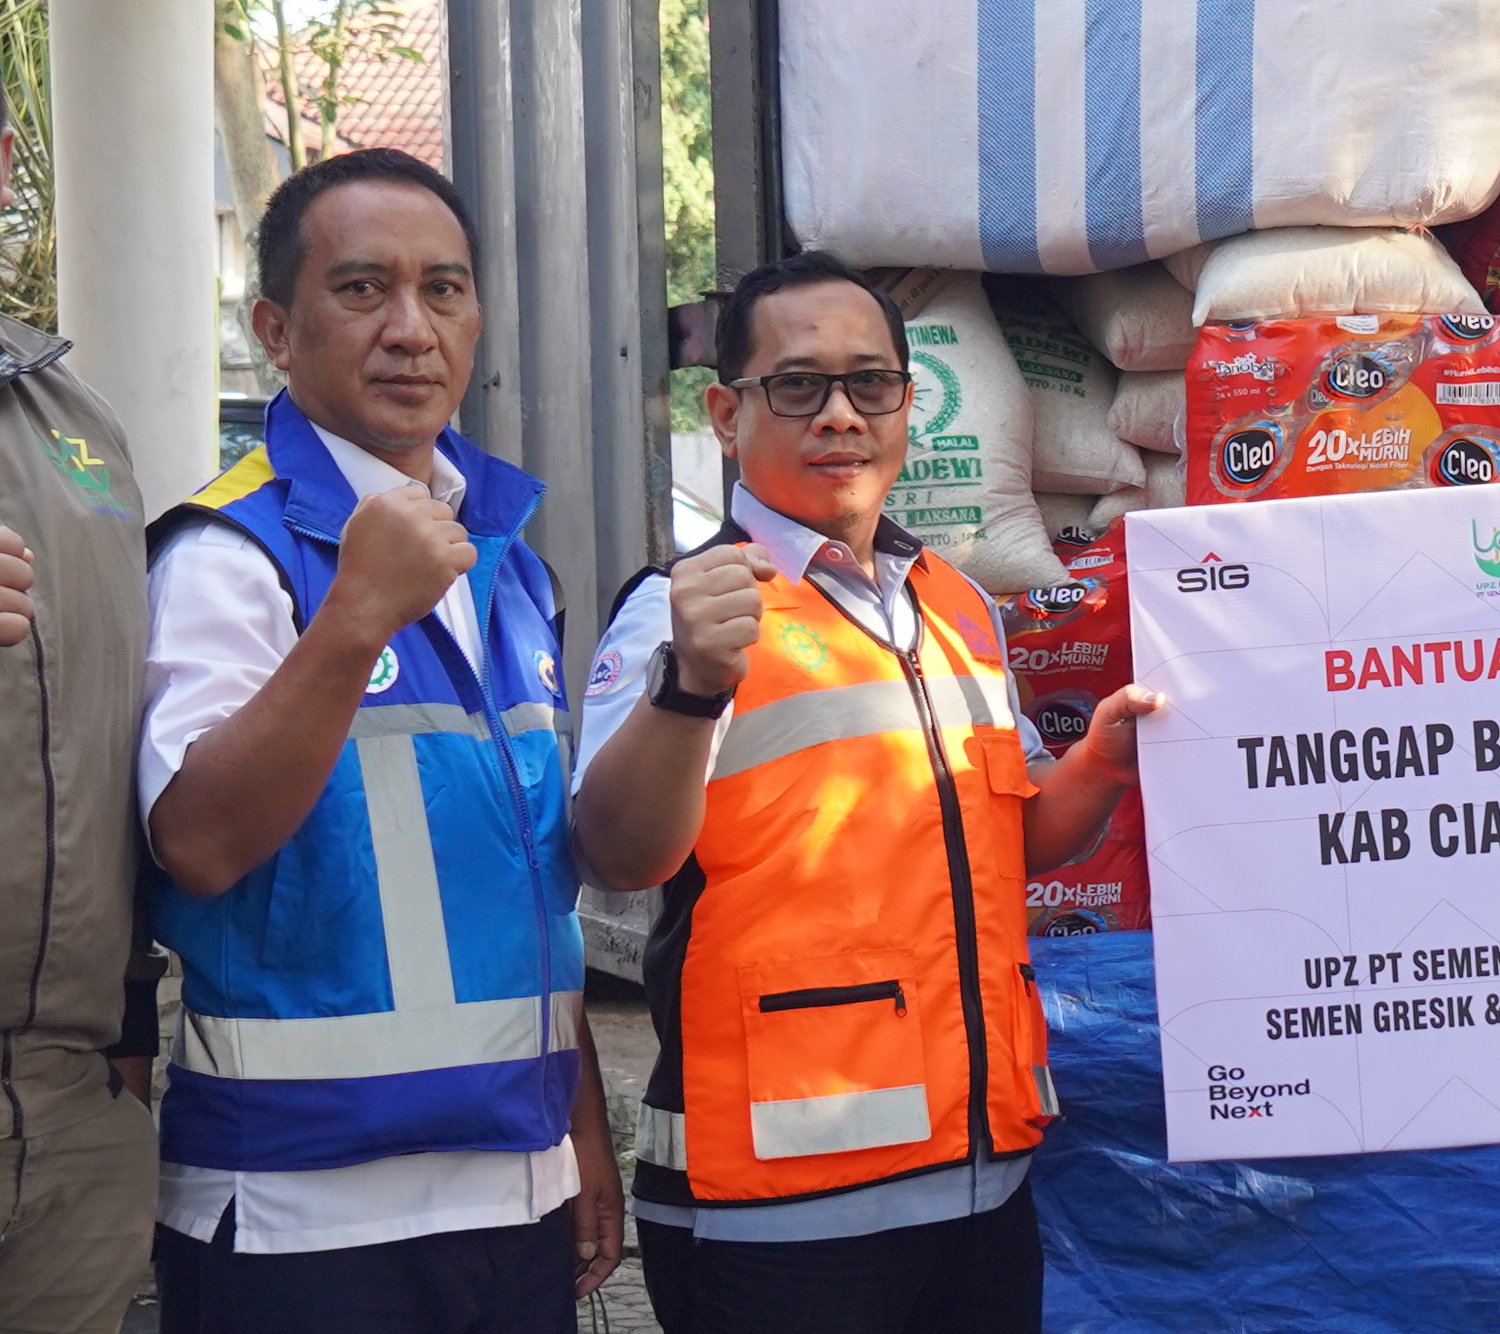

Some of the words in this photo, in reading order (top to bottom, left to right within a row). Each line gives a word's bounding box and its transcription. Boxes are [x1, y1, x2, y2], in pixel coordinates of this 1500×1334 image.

[906, 324, 959, 347] TIMEWA
[1335, 364, 1385, 388] Cleo
[937, 437, 976, 449] HALAL
[1360, 427, 1412, 448] LEBIH
[1228, 441, 1275, 472] Cleo
[1359, 445, 1409, 462] MURNI
[1446, 449, 1493, 482] Cleo
[921, 533, 951, 547] ETTO
[1059, 524, 1096, 541] Cle
[1176, 563, 1250, 593] SIG
[1476, 581, 1496, 590] UPZ
[1035, 587, 1086, 603] Cleo
[1061, 641, 1110, 656] LEBIH
[1059, 652, 1106, 667] MURNI
[1041, 711, 1086, 734] Cleo
[1237, 723, 1454, 789] TANGGAP
[1318, 808, 1411, 865] KAB
[1076, 881, 1122, 897] LEBIH
[1075, 892, 1121, 907] MURNI
[1304, 956, 1359, 989] UPZ
[1369, 952, 1402, 985] PT
[1266, 1003, 1362, 1040] SEMEN
[1373, 995, 1475, 1033] GRESIK
[1207, 1064, 1245, 1082] Go
[1209, 1078, 1311, 1103] Beyond
[1210, 1101, 1274, 1120] Next
